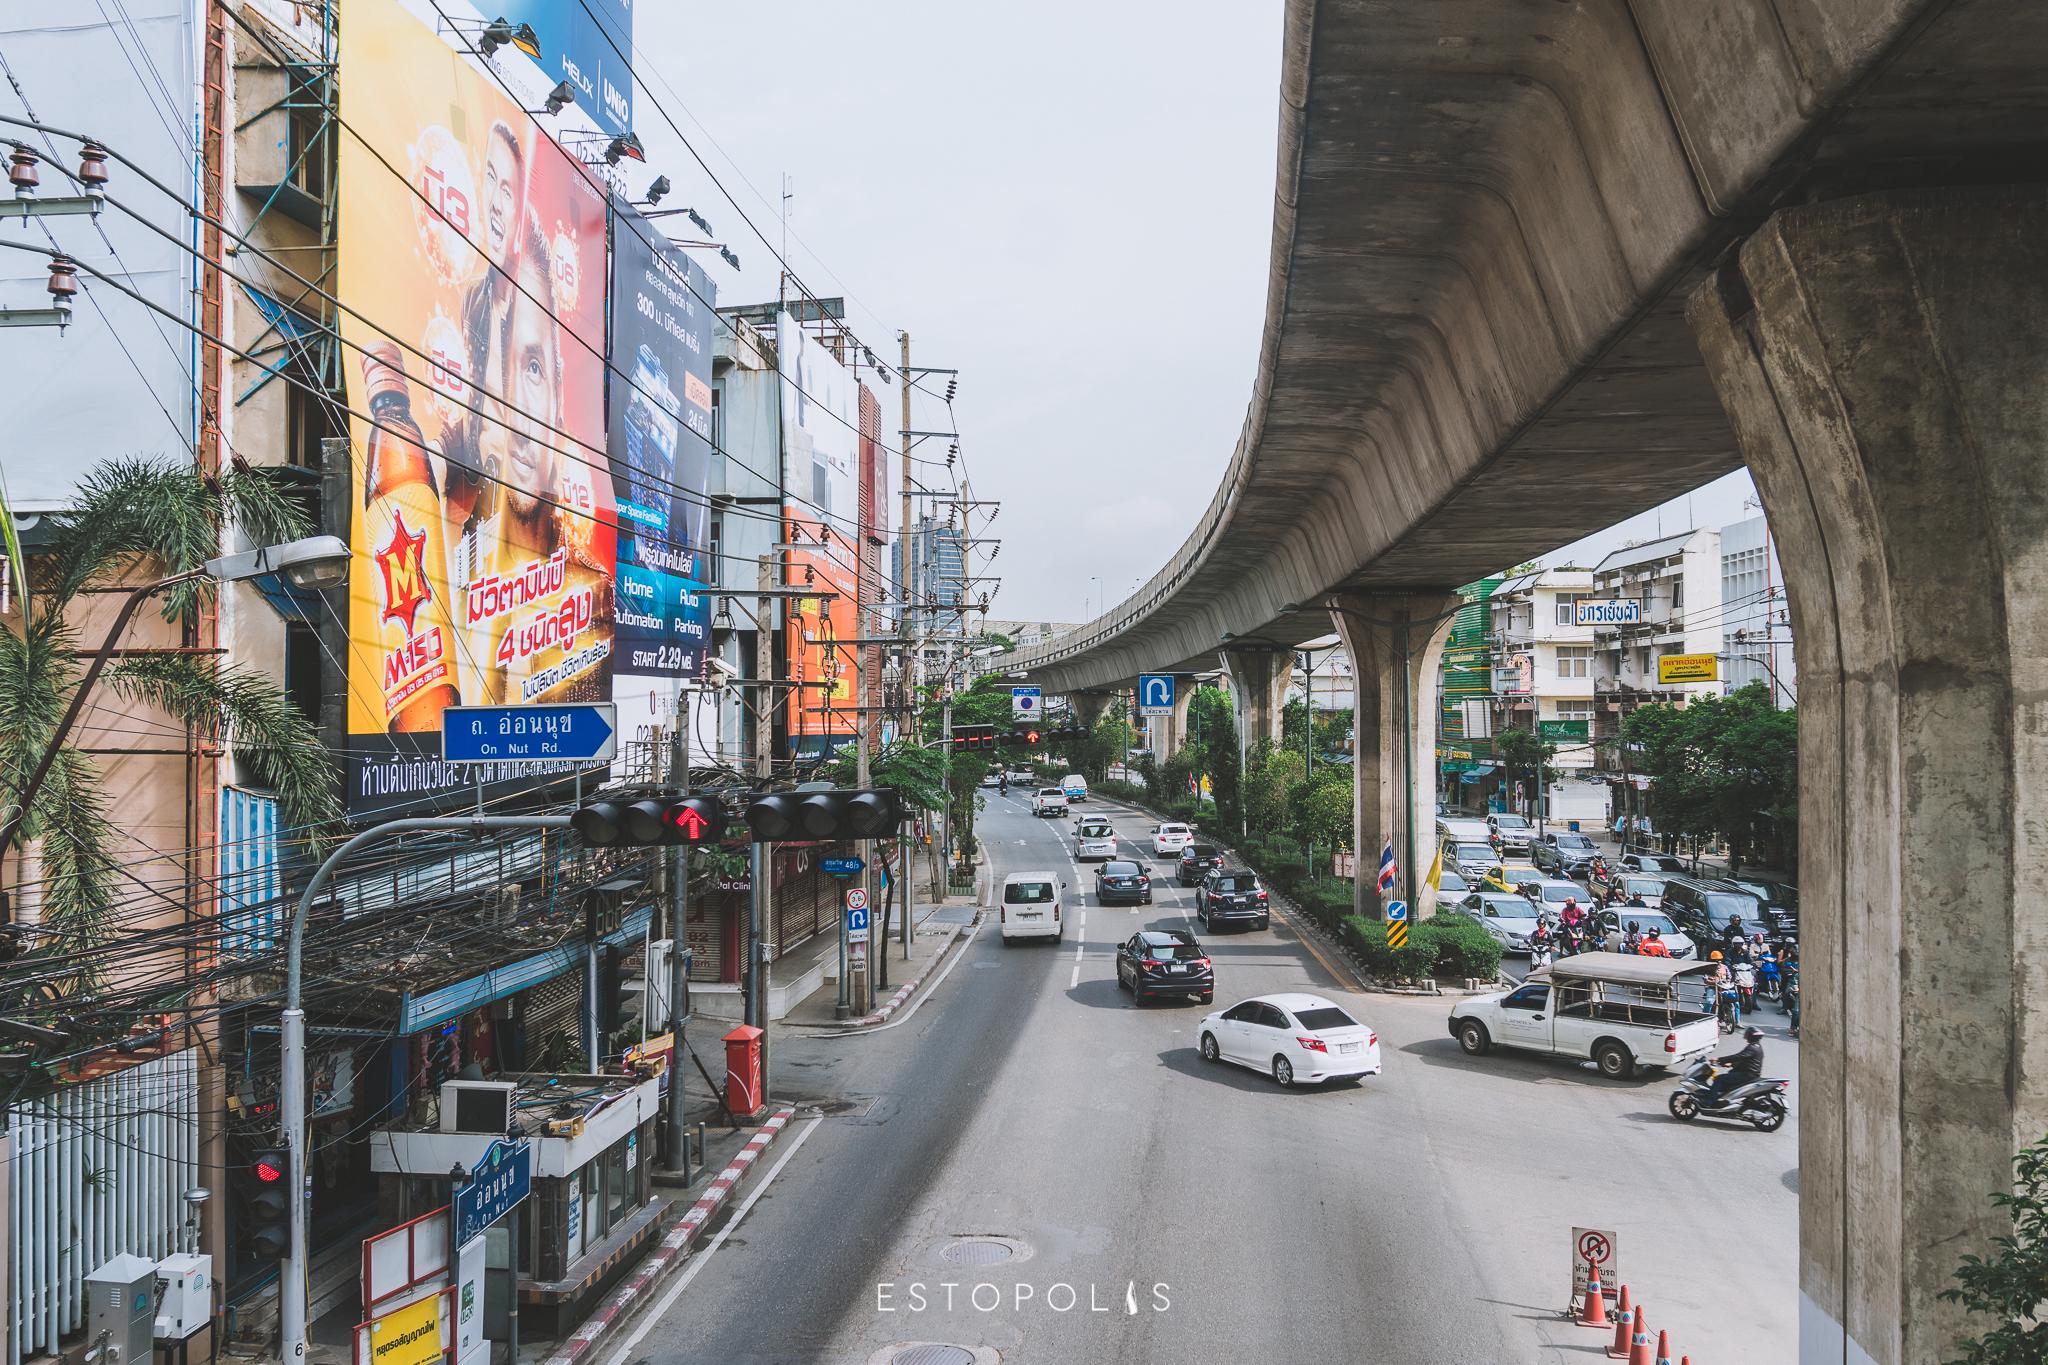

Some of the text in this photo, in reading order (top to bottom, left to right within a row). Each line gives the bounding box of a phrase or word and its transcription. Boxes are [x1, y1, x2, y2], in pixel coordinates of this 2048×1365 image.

[562, 54, 594, 99] HELIX
[637, 292, 655, 320] 300
[627, 505, 643, 518] Space
[468, 553, 567, 625] มีวิตามินบี
[624, 575, 654, 599] Home
[497, 591, 593, 666] 4 ชนิดสูง
[614, 607, 703, 640] Automation Parking
[632, 650, 658, 668] START
[657, 645, 682, 670] 2.29
[471, 712, 572, 740] ถ. อ่อนนุช
[481, 742, 562, 755] On Nut Rd.
[362, 748, 460, 797] ห้ามดื่มเกินวันละ
[463, 761, 470, 785] 2
[732, 881, 751, 890] Clini
[476, 1164, 515, 1211] อ่อนนุช
[294, 1342, 304, 1357] 6
[376, 1319, 435, 1357] หยุดรอสัญญาณไฟ
